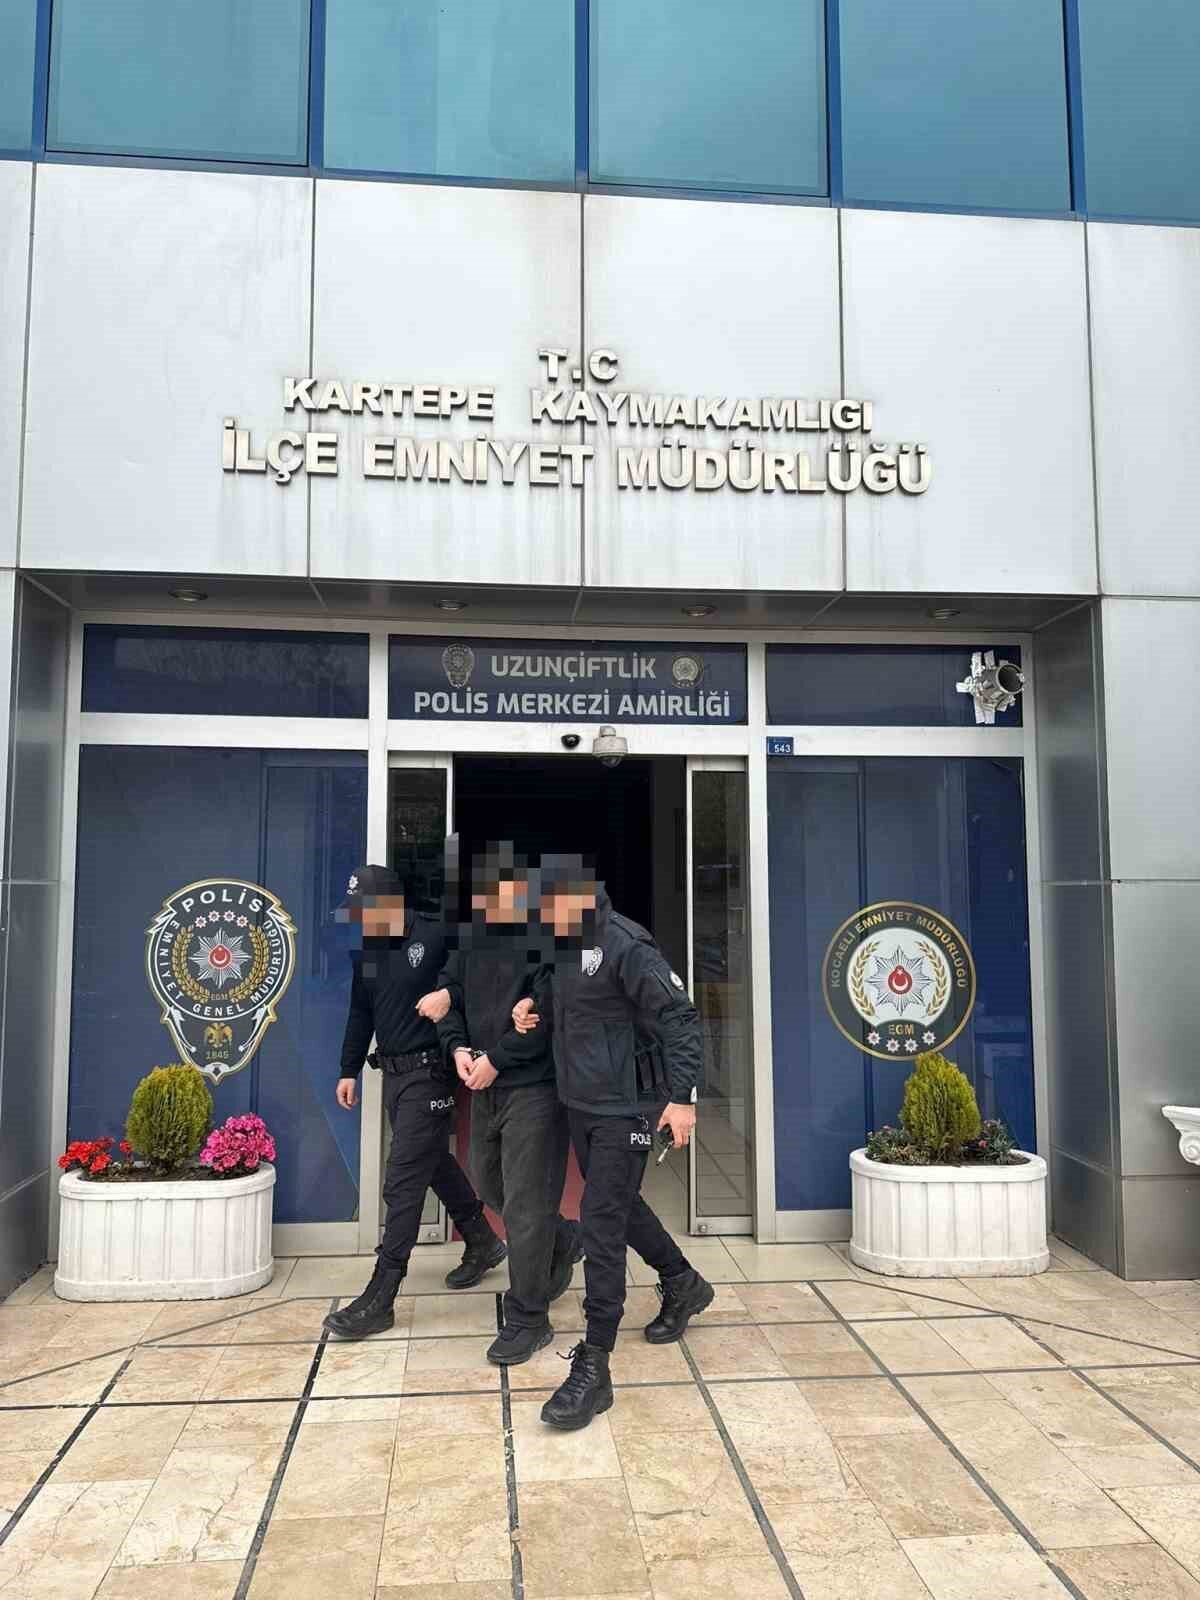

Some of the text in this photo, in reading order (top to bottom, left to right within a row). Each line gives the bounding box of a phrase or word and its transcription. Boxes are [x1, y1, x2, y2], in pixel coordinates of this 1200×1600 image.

[538, 348, 618, 382] T.C
[283, 376, 873, 433] KARTEPE KAYMAKAMLIGI
[222, 415, 931, 496] İLÇE EMNİYET MÜDÜRLÜĞÜ
[491, 652, 657, 682] UZUNÇİFTLİK
[414, 686, 731, 717] POLİS MERKEZİ AMİRLİĞİ
[774, 744, 791, 753] 543
[181, 888, 264, 913] POLİS
[192, 1003, 245, 1017] GENEL
[888, 1024, 915, 1036] EGM
